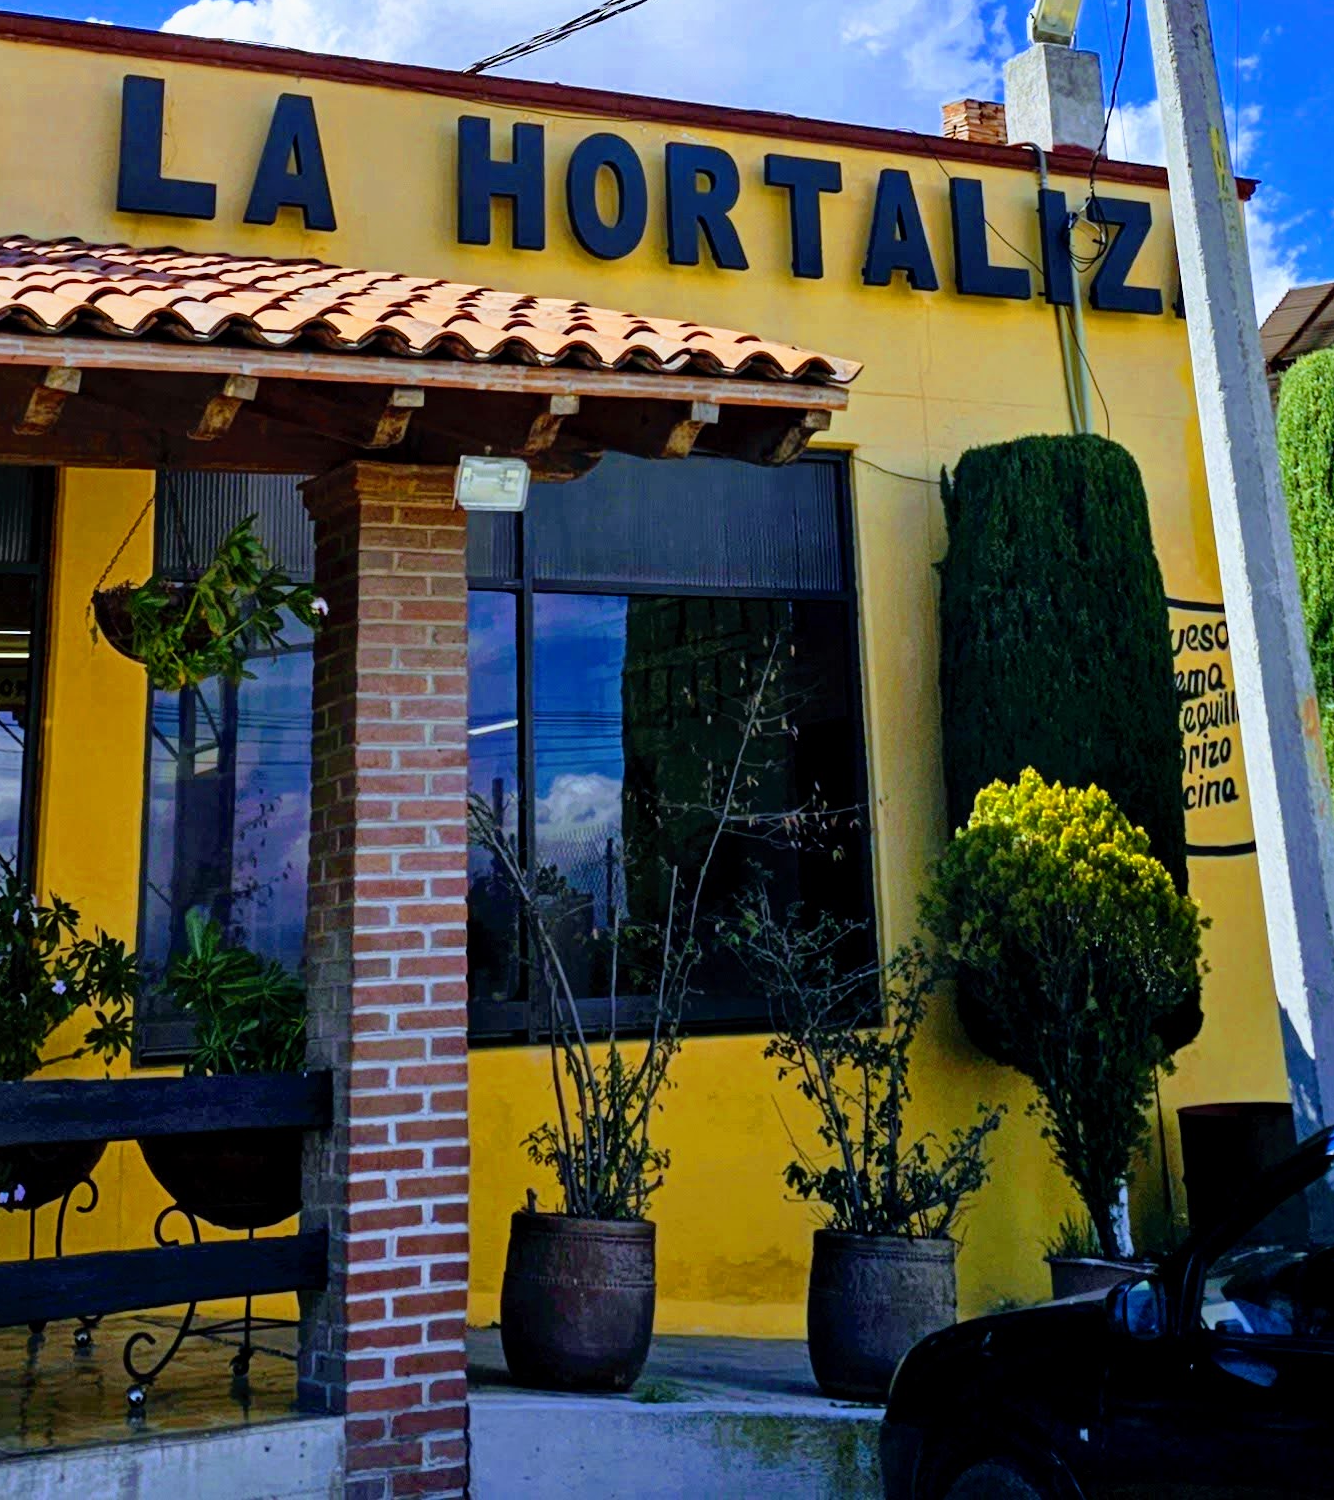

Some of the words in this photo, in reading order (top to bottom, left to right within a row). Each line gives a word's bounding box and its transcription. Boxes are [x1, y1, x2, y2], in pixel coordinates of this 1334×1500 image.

[117, 74, 337, 232] LA
[457, 114, 1187, 320] HORTALIZ
[1169, 619, 1229, 657] ueso
[1175, 662, 1226, 695] ema
[1178, 691, 1240, 736] equill
[1181, 732, 1231, 773] rizo
[1183, 776, 1240, 810] cina
